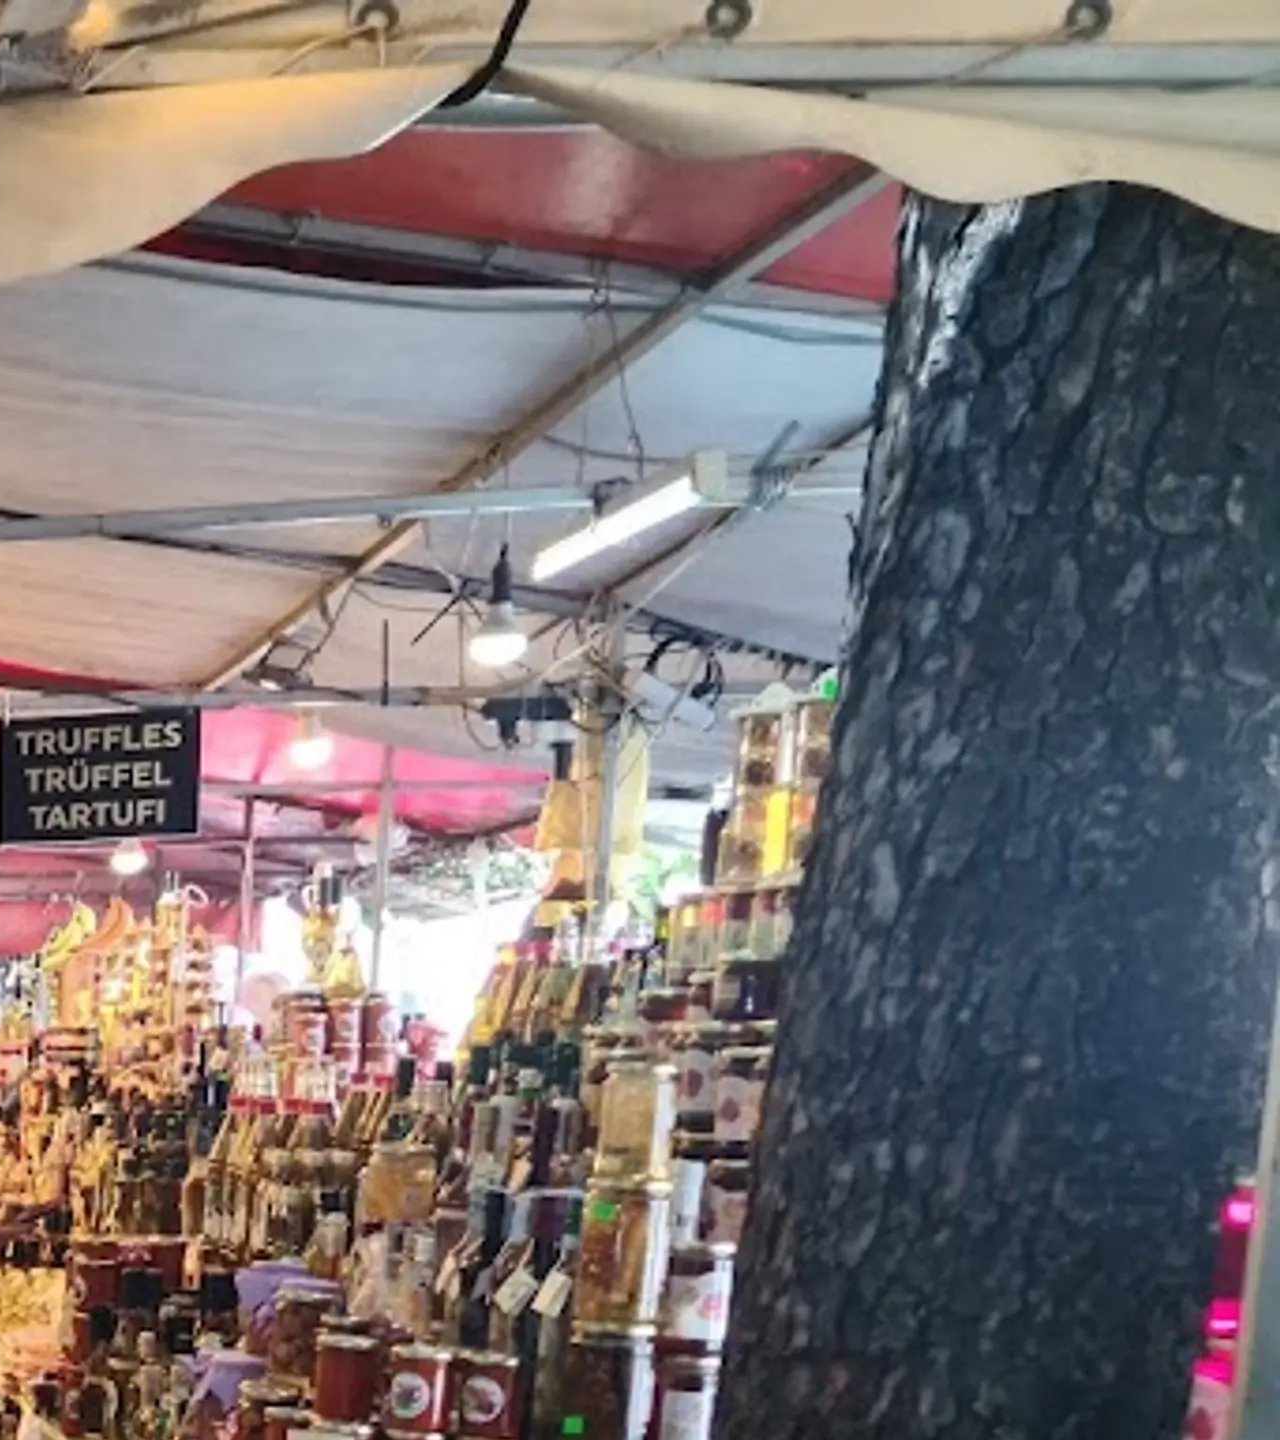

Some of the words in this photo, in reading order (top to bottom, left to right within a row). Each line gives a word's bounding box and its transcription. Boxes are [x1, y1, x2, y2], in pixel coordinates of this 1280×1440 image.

[15, 720, 182, 756] TRUFFLES
[24, 758, 172, 793] TRÜFFEL
[28, 798, 164, 831] TARTUFI
